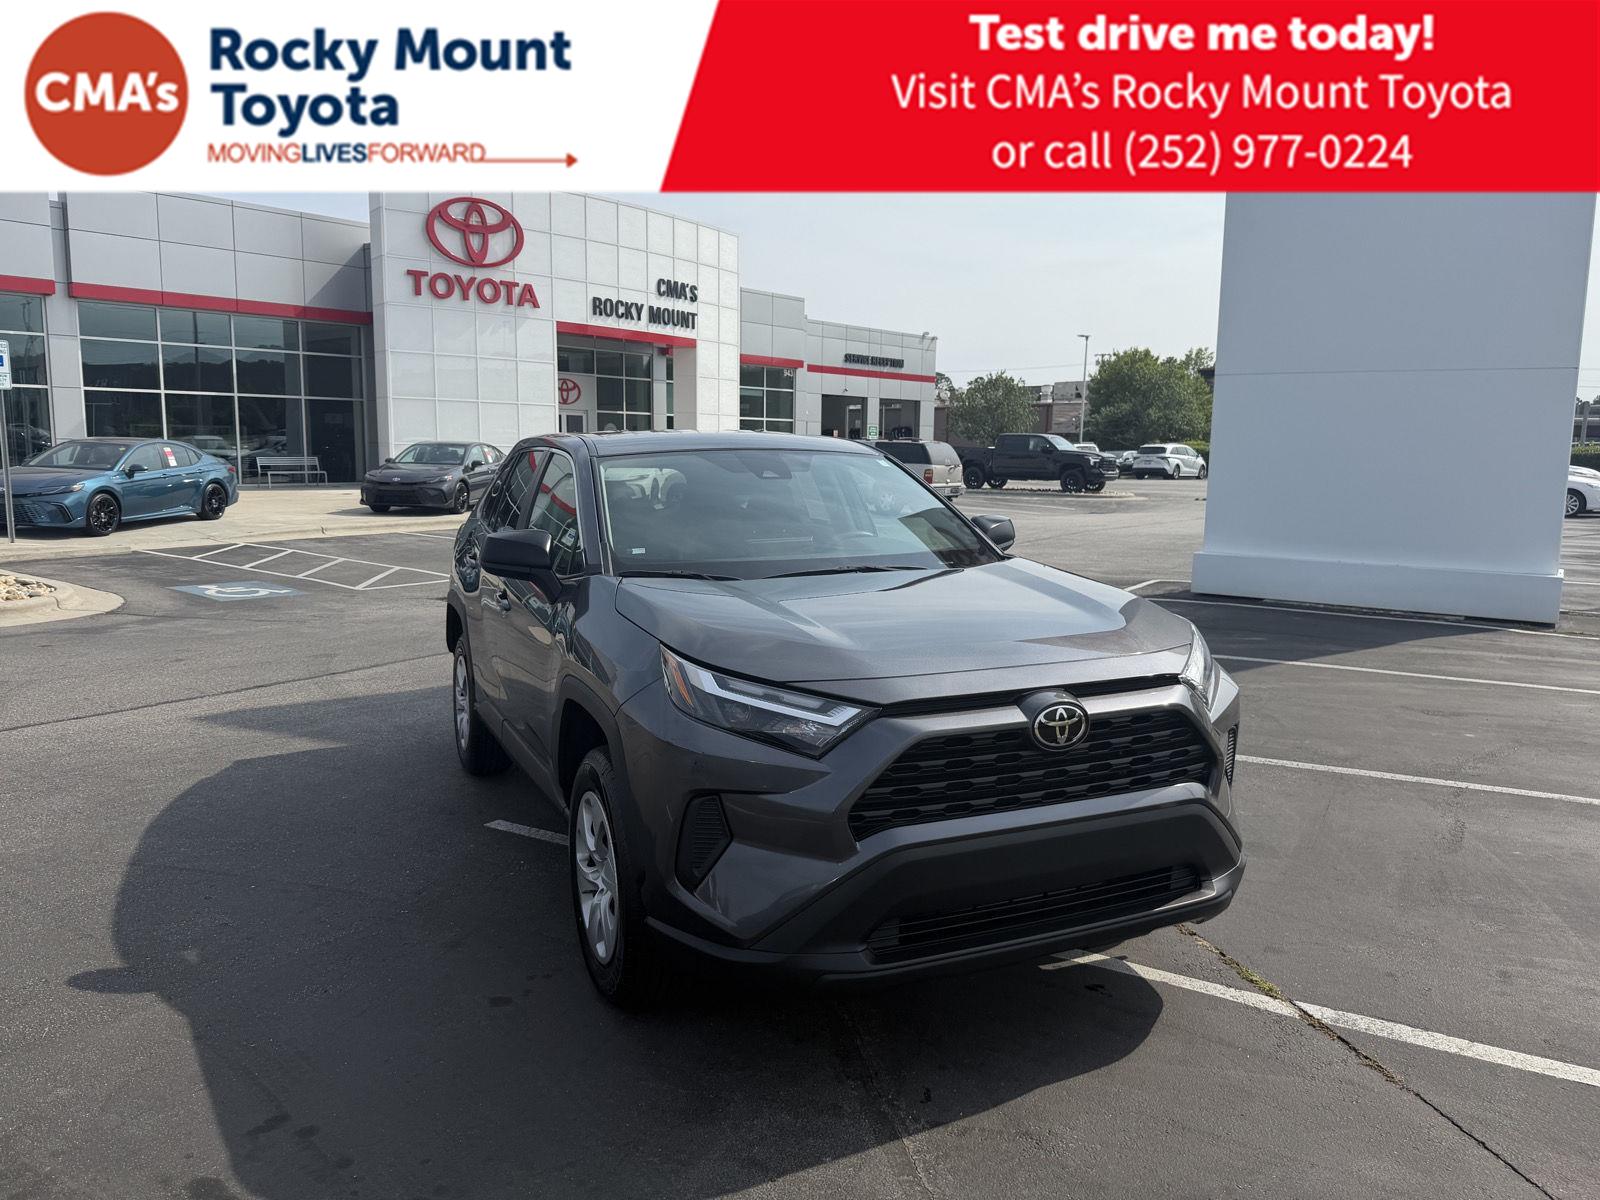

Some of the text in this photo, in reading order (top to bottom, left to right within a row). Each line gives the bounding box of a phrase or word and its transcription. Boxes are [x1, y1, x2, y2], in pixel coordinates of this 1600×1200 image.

[407, 269, 540, 309] TOYOTA
[656, 278, 698, 303] CMA'S
[592, 296, 697, 330] ROCKY MOUNT
